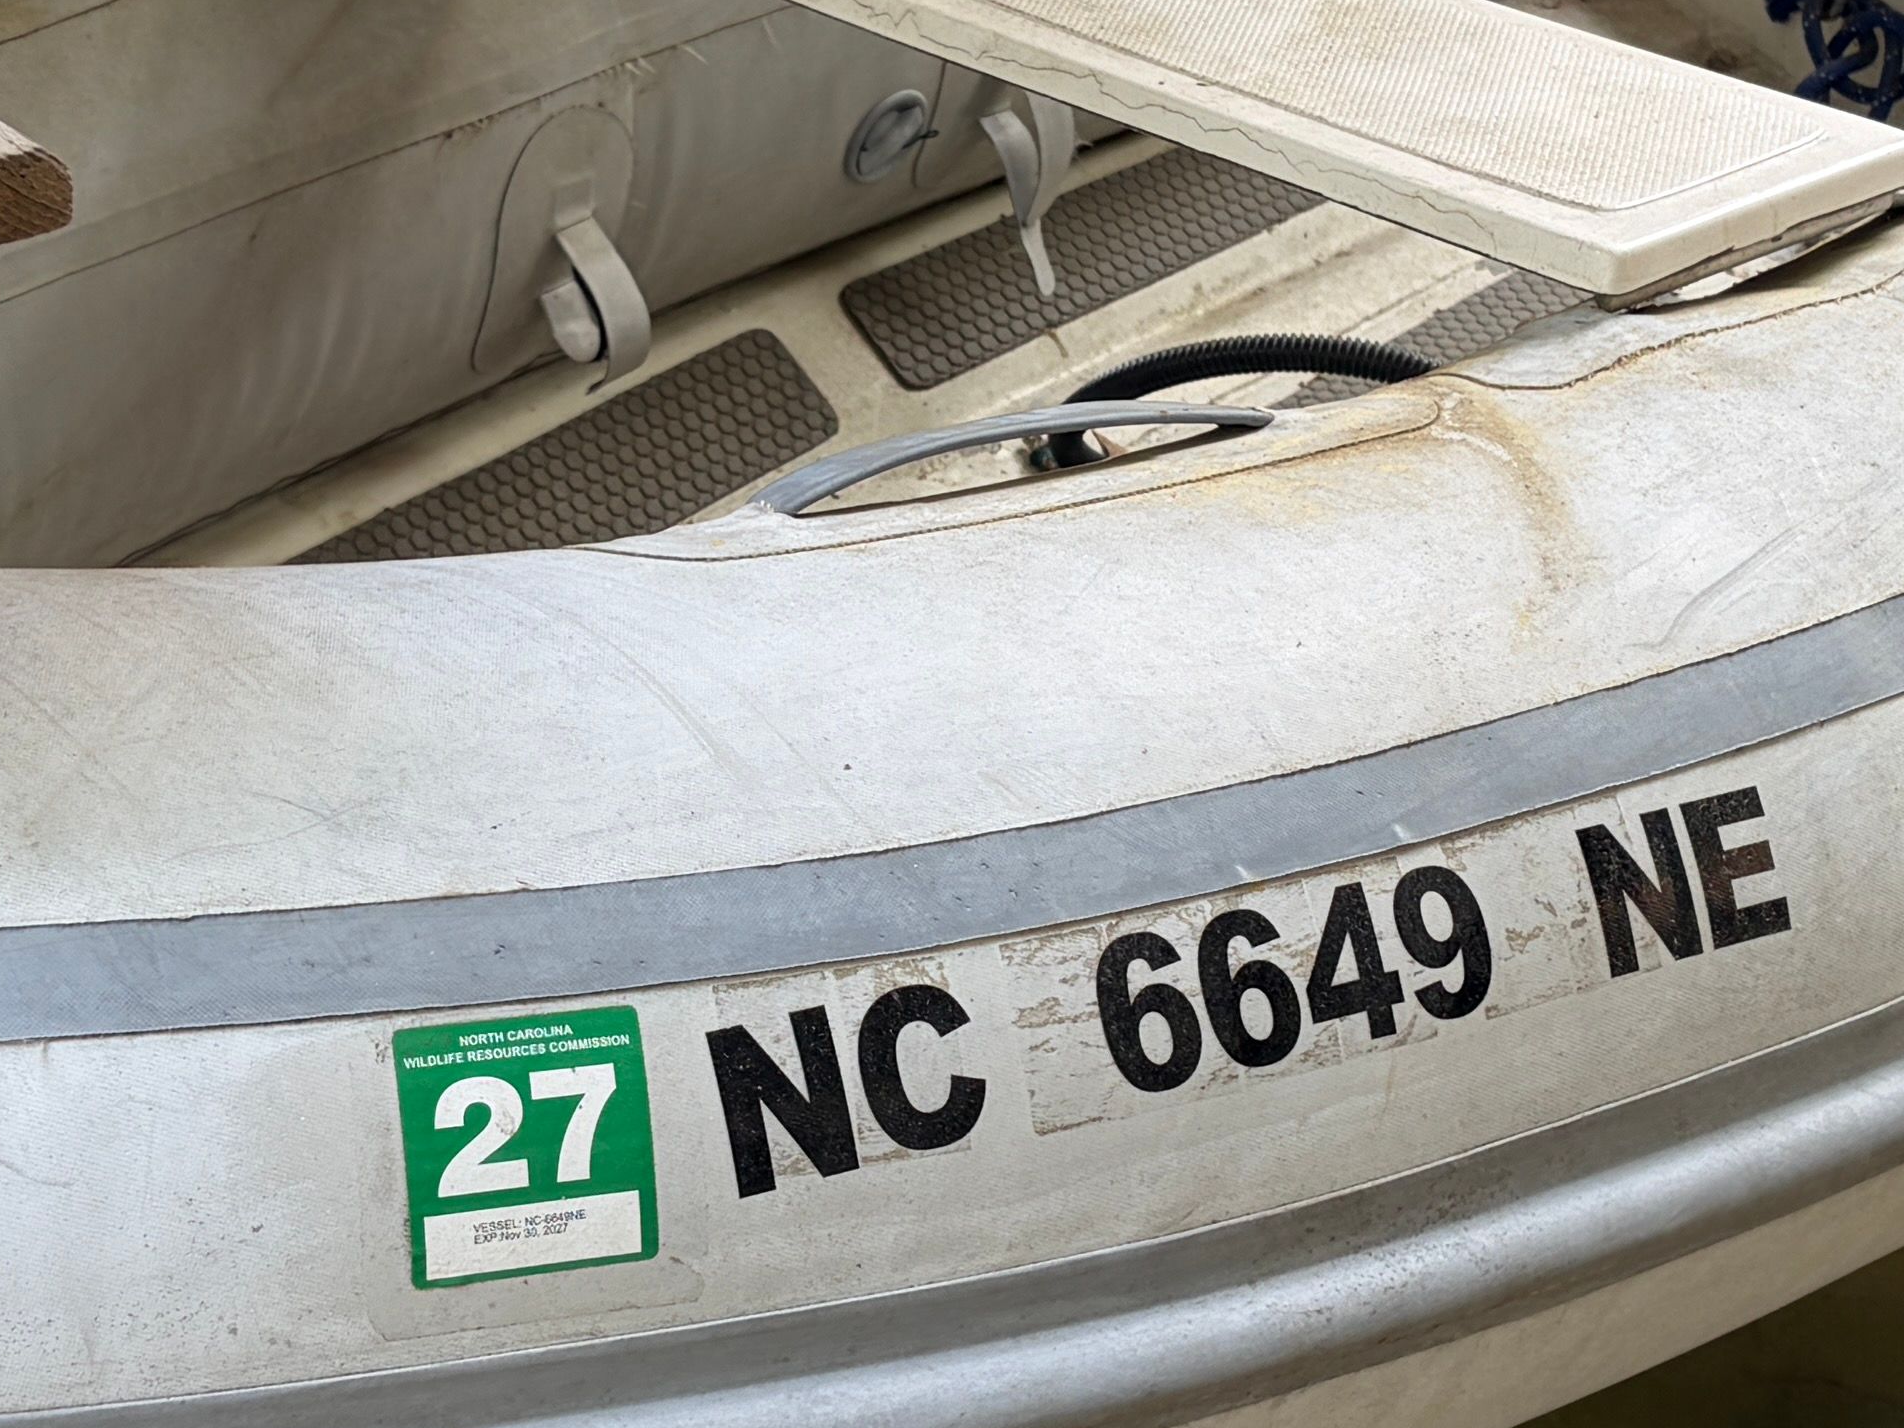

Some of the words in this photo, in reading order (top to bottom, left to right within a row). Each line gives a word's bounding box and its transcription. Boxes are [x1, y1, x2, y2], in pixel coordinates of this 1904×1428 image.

[705, 983, 987, 1199] NC
[1094, 865, 1493, 1094] 6649
[1575, 785, 1792, 978] NE
[458, 1031, 505, 1047] NORTH
[507, 1024, 574, 1042] CAROLINA
[403, 1051, 465, 1069] WILDLIFE
[467, 1043, 547, 1062] RESOURCES
[548, 1034, 630, 1053] COMMISSION
[433, 1062, 617, 1199] 27
[473, 1218, 522, 1233] VESSEL:
[542, 1222, 568, 1236] 2027
